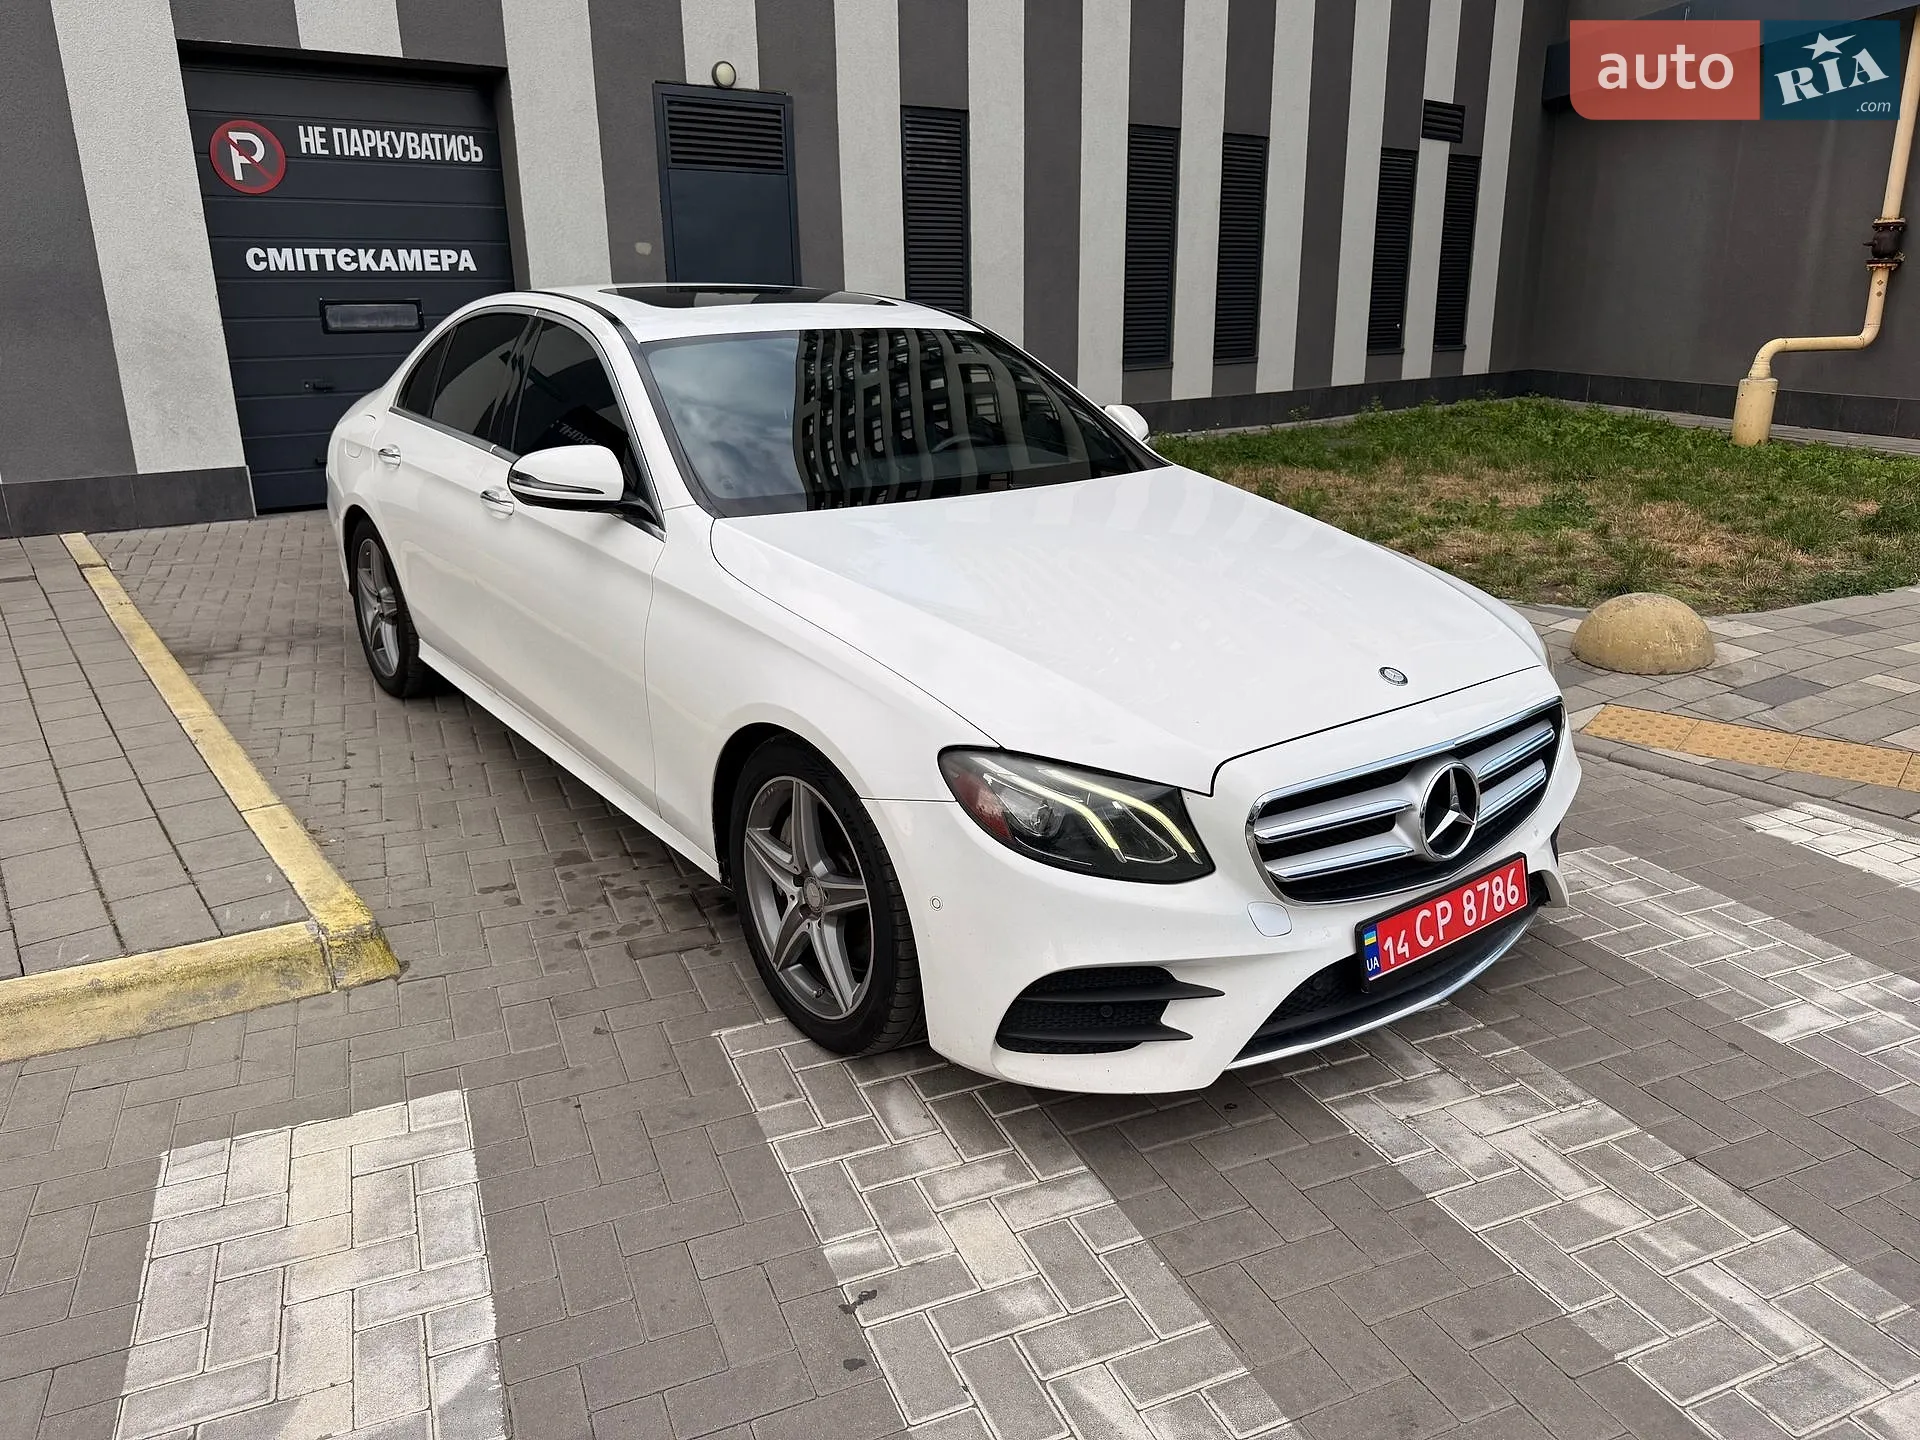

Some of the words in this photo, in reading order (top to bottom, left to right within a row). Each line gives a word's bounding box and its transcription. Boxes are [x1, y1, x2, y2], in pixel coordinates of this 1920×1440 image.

[298, 125, 329, 155] НЕ
[332, 127, 484, 163] ПАРКУВАТИСЬ
[245, 247, 478, 272] СМІТТЄКАМЕРА
[1383, 929, 1410, 965] 14
[1415, 900, 1453, 948] CP
[1462, 867, 1520, 927] 8786
[1366, 956, 1380, 972] UA
